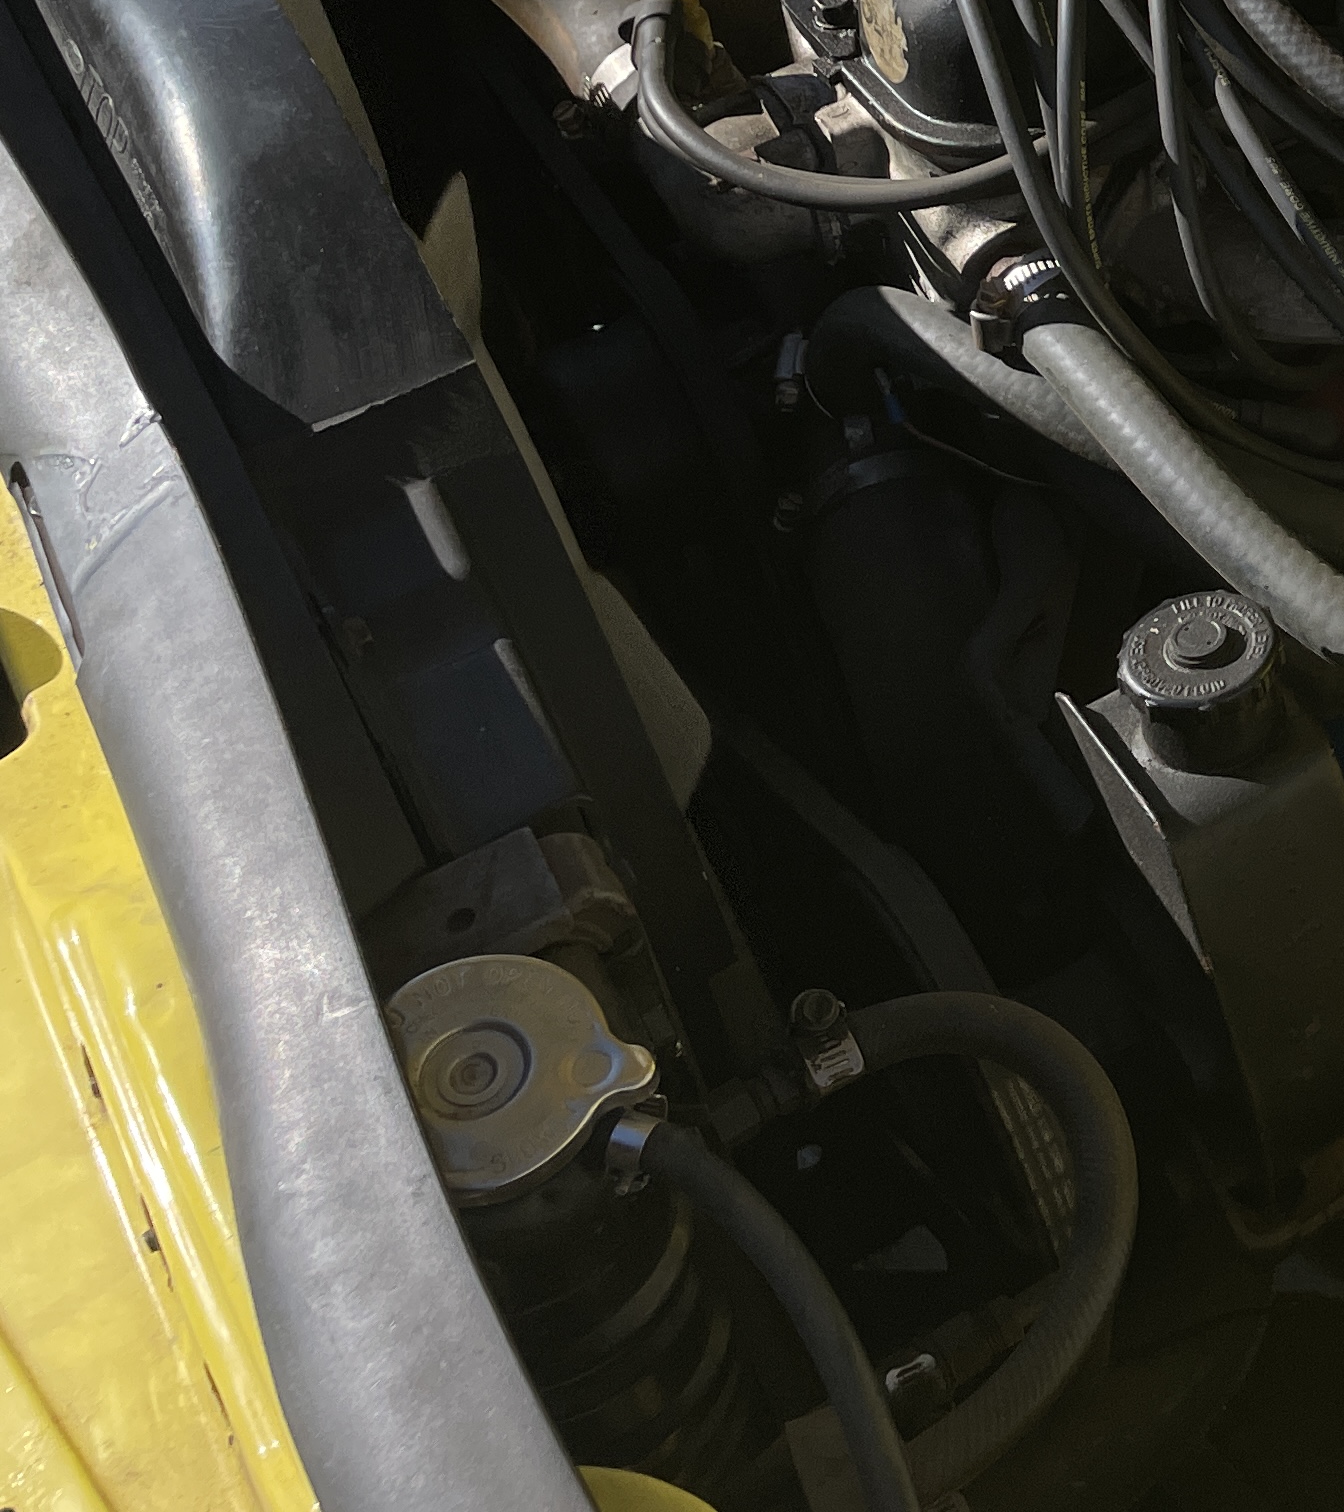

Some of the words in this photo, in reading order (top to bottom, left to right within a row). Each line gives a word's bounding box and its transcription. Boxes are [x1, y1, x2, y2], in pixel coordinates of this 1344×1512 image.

[1279, 181, 1304, 211] CORE
[1301, 212, 1340, 265] INDUCTIVE
[1171, 596, 1198, 614] FILL
[1206, 595, 1223, 608] TO
